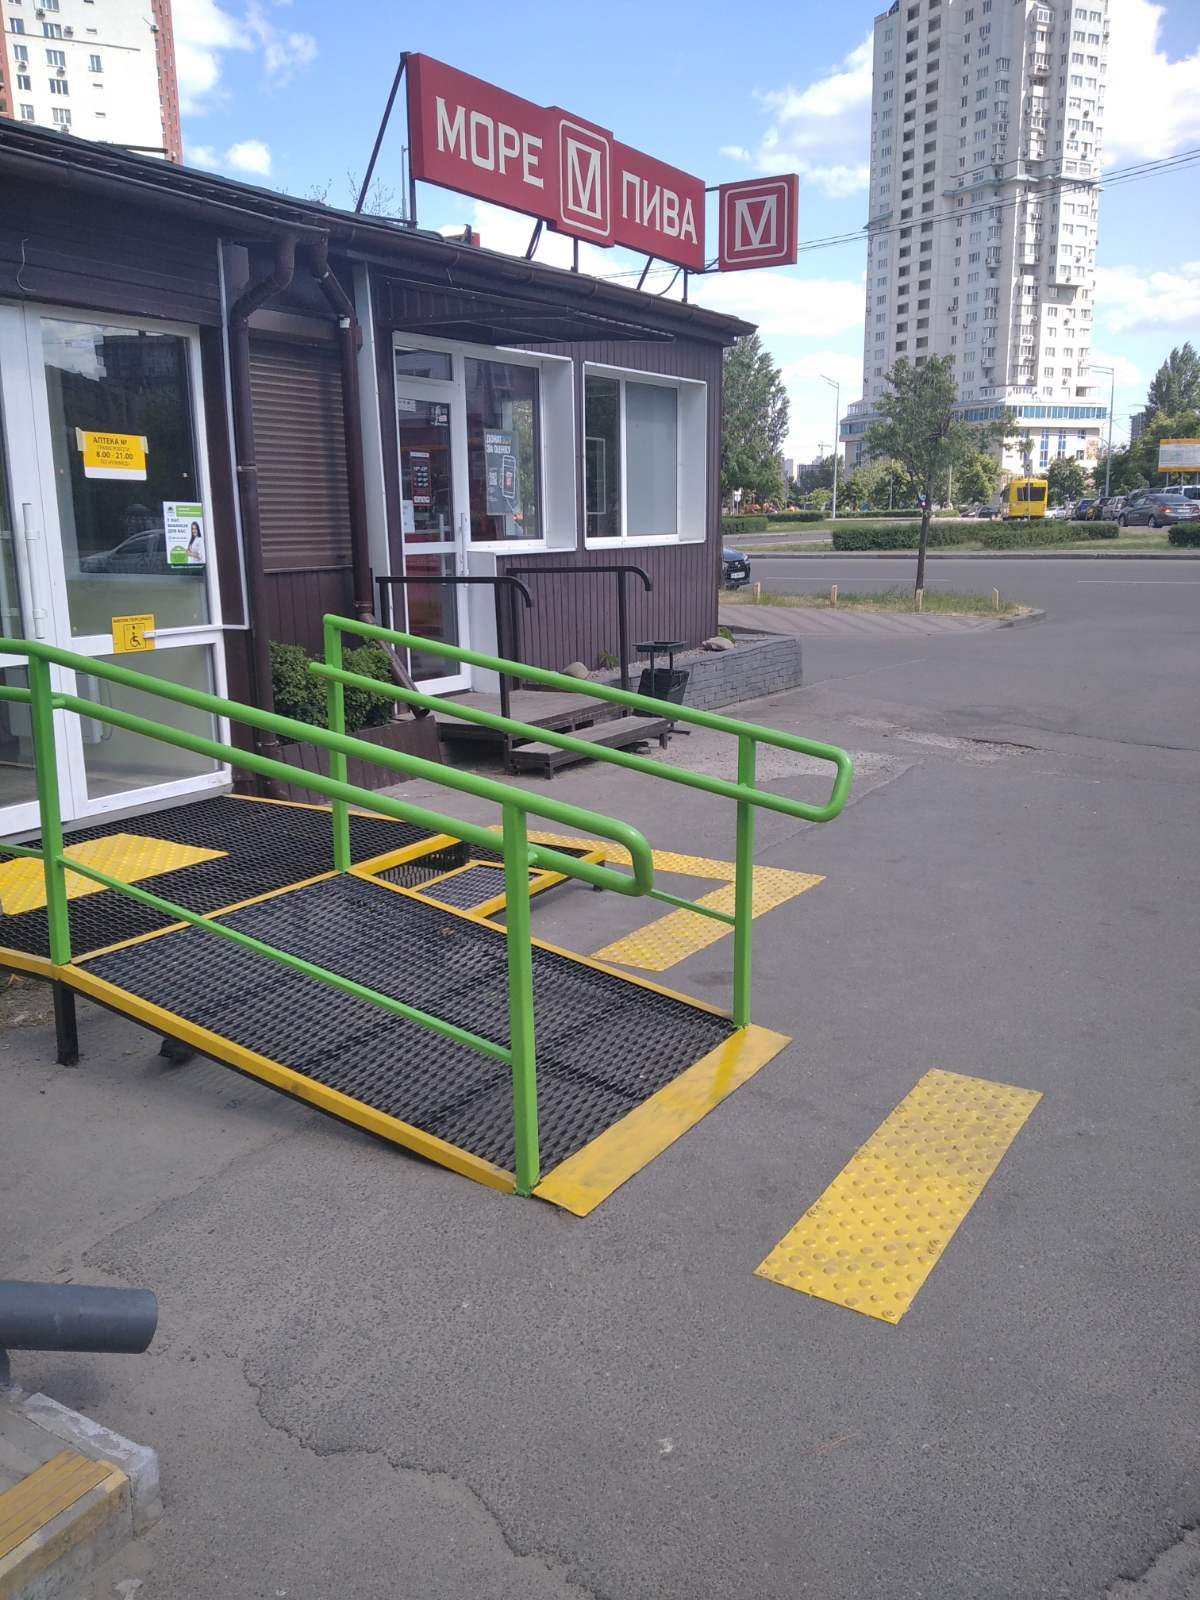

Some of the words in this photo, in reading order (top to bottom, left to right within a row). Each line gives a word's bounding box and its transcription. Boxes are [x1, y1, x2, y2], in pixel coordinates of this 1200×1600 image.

[435, 95, 545, 190] МОРЕ
[621, 170, 698, 245] ПИВА
[93, 437, 119, 445] АПТЕКА
[115, 452, 134, 460] 21.00
